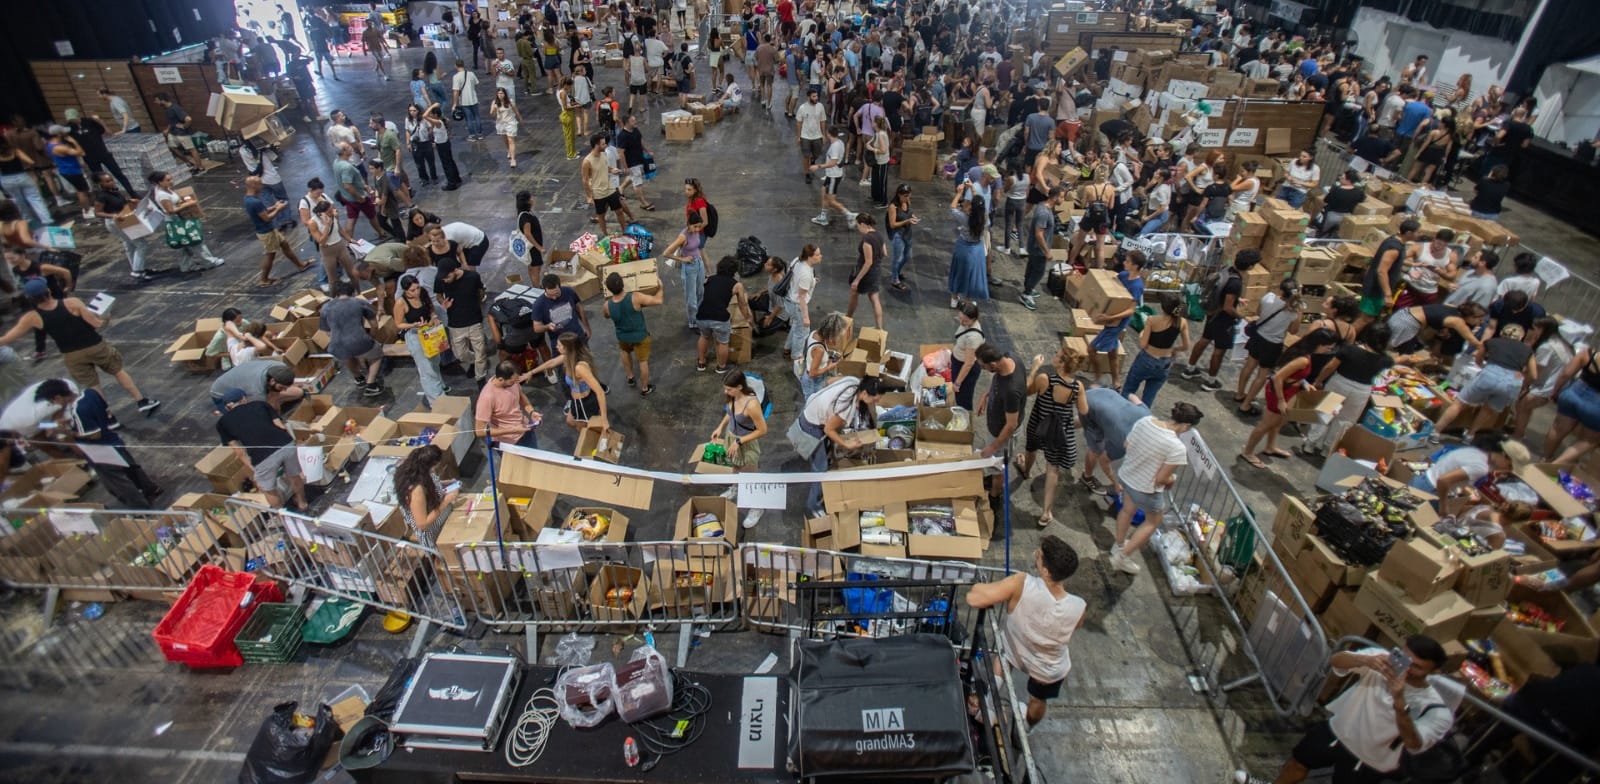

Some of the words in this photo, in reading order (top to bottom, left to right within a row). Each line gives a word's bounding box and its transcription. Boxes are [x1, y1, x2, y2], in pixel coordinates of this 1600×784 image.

[749, 698, 764, 742] מוצרי
[865, 709, 902, 730] MA
[855, 732, 916, 755] grandMA3
